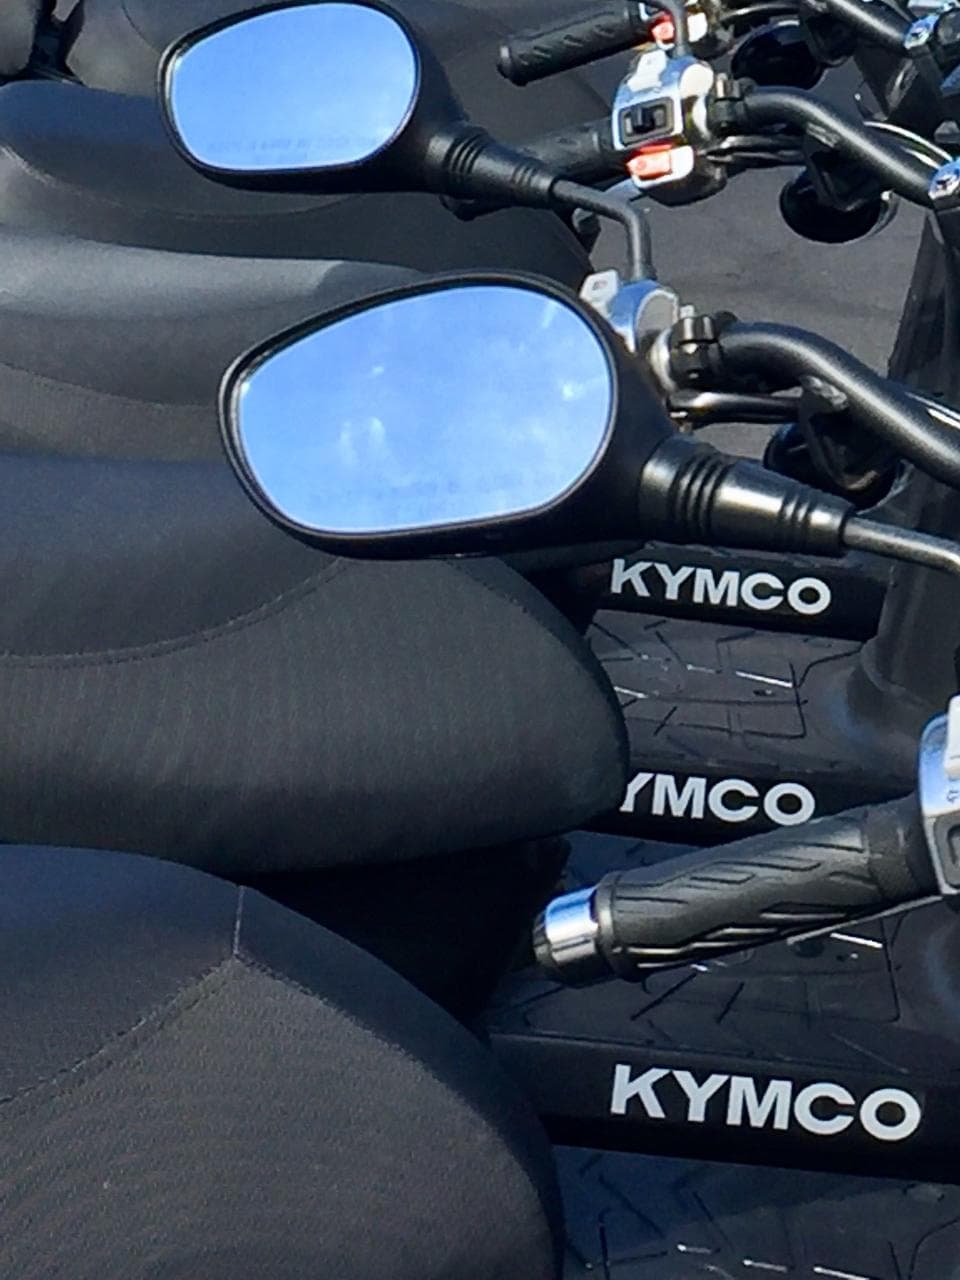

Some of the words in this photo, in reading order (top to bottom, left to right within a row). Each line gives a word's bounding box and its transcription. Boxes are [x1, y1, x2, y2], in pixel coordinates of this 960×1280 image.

[610, 558, 832, 615] KYMCO
[619, 772, 816, 826] YMCO
[610, 1064, 922, 1141] KYMCO
